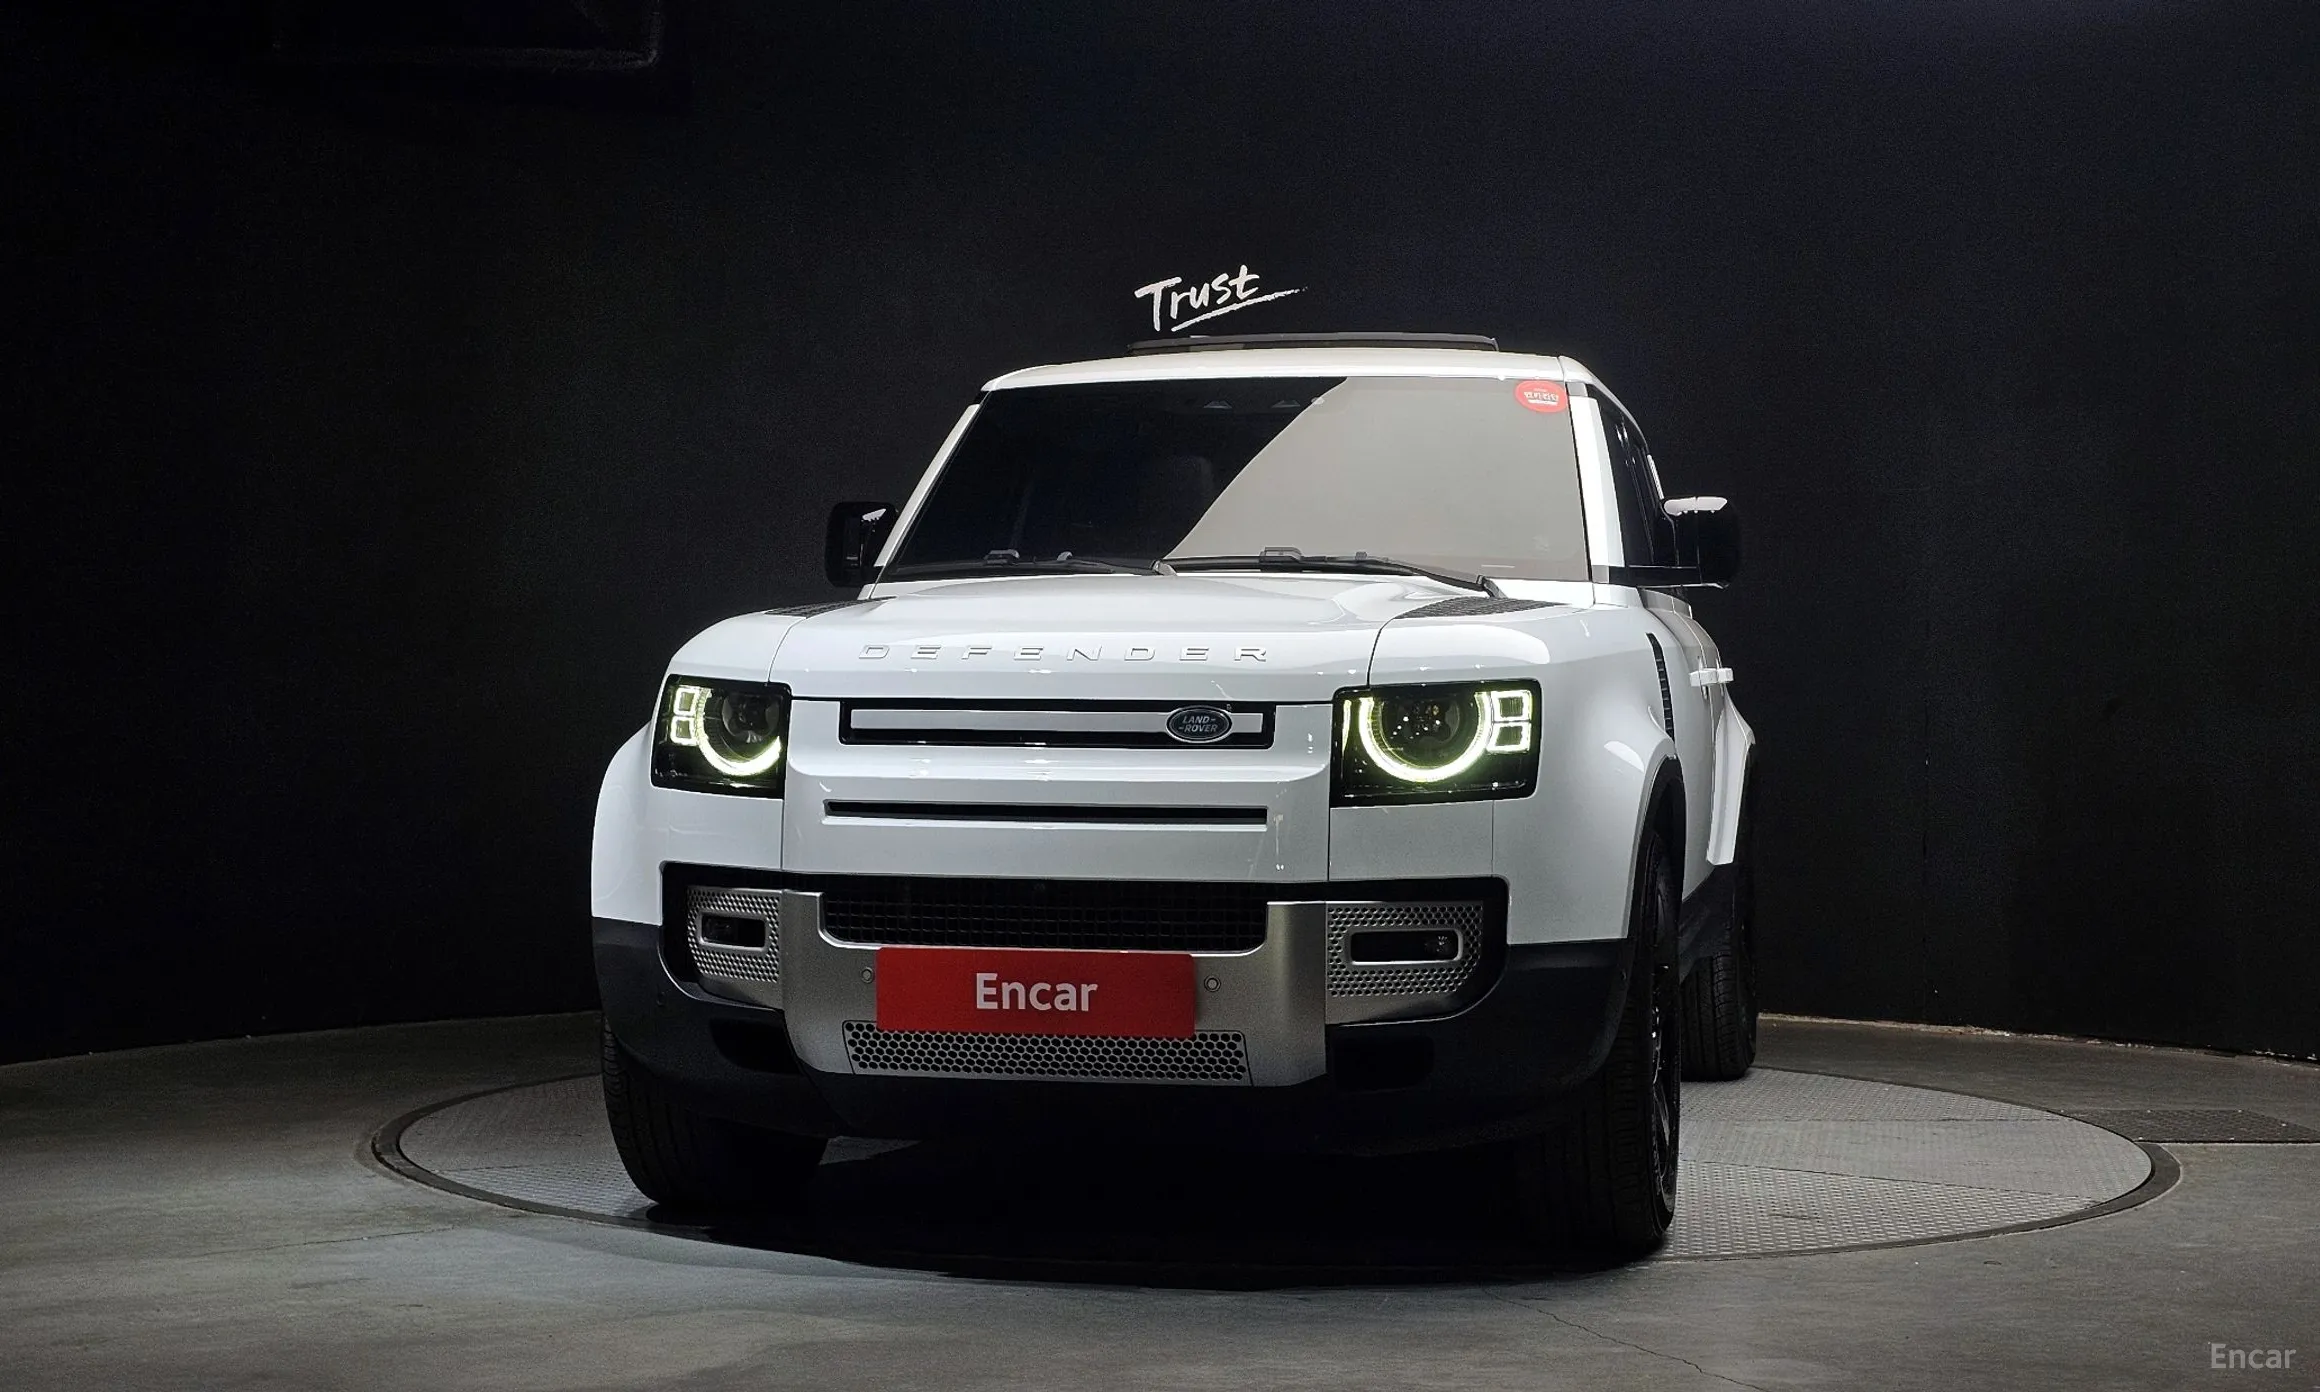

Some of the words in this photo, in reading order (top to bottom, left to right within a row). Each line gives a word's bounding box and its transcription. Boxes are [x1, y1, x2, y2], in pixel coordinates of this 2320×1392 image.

[1134, 265, 1260, 332] Trust
[858, 644, 1267, 663] DEFENDER
[976, 972, 1099, 1012] Encar
